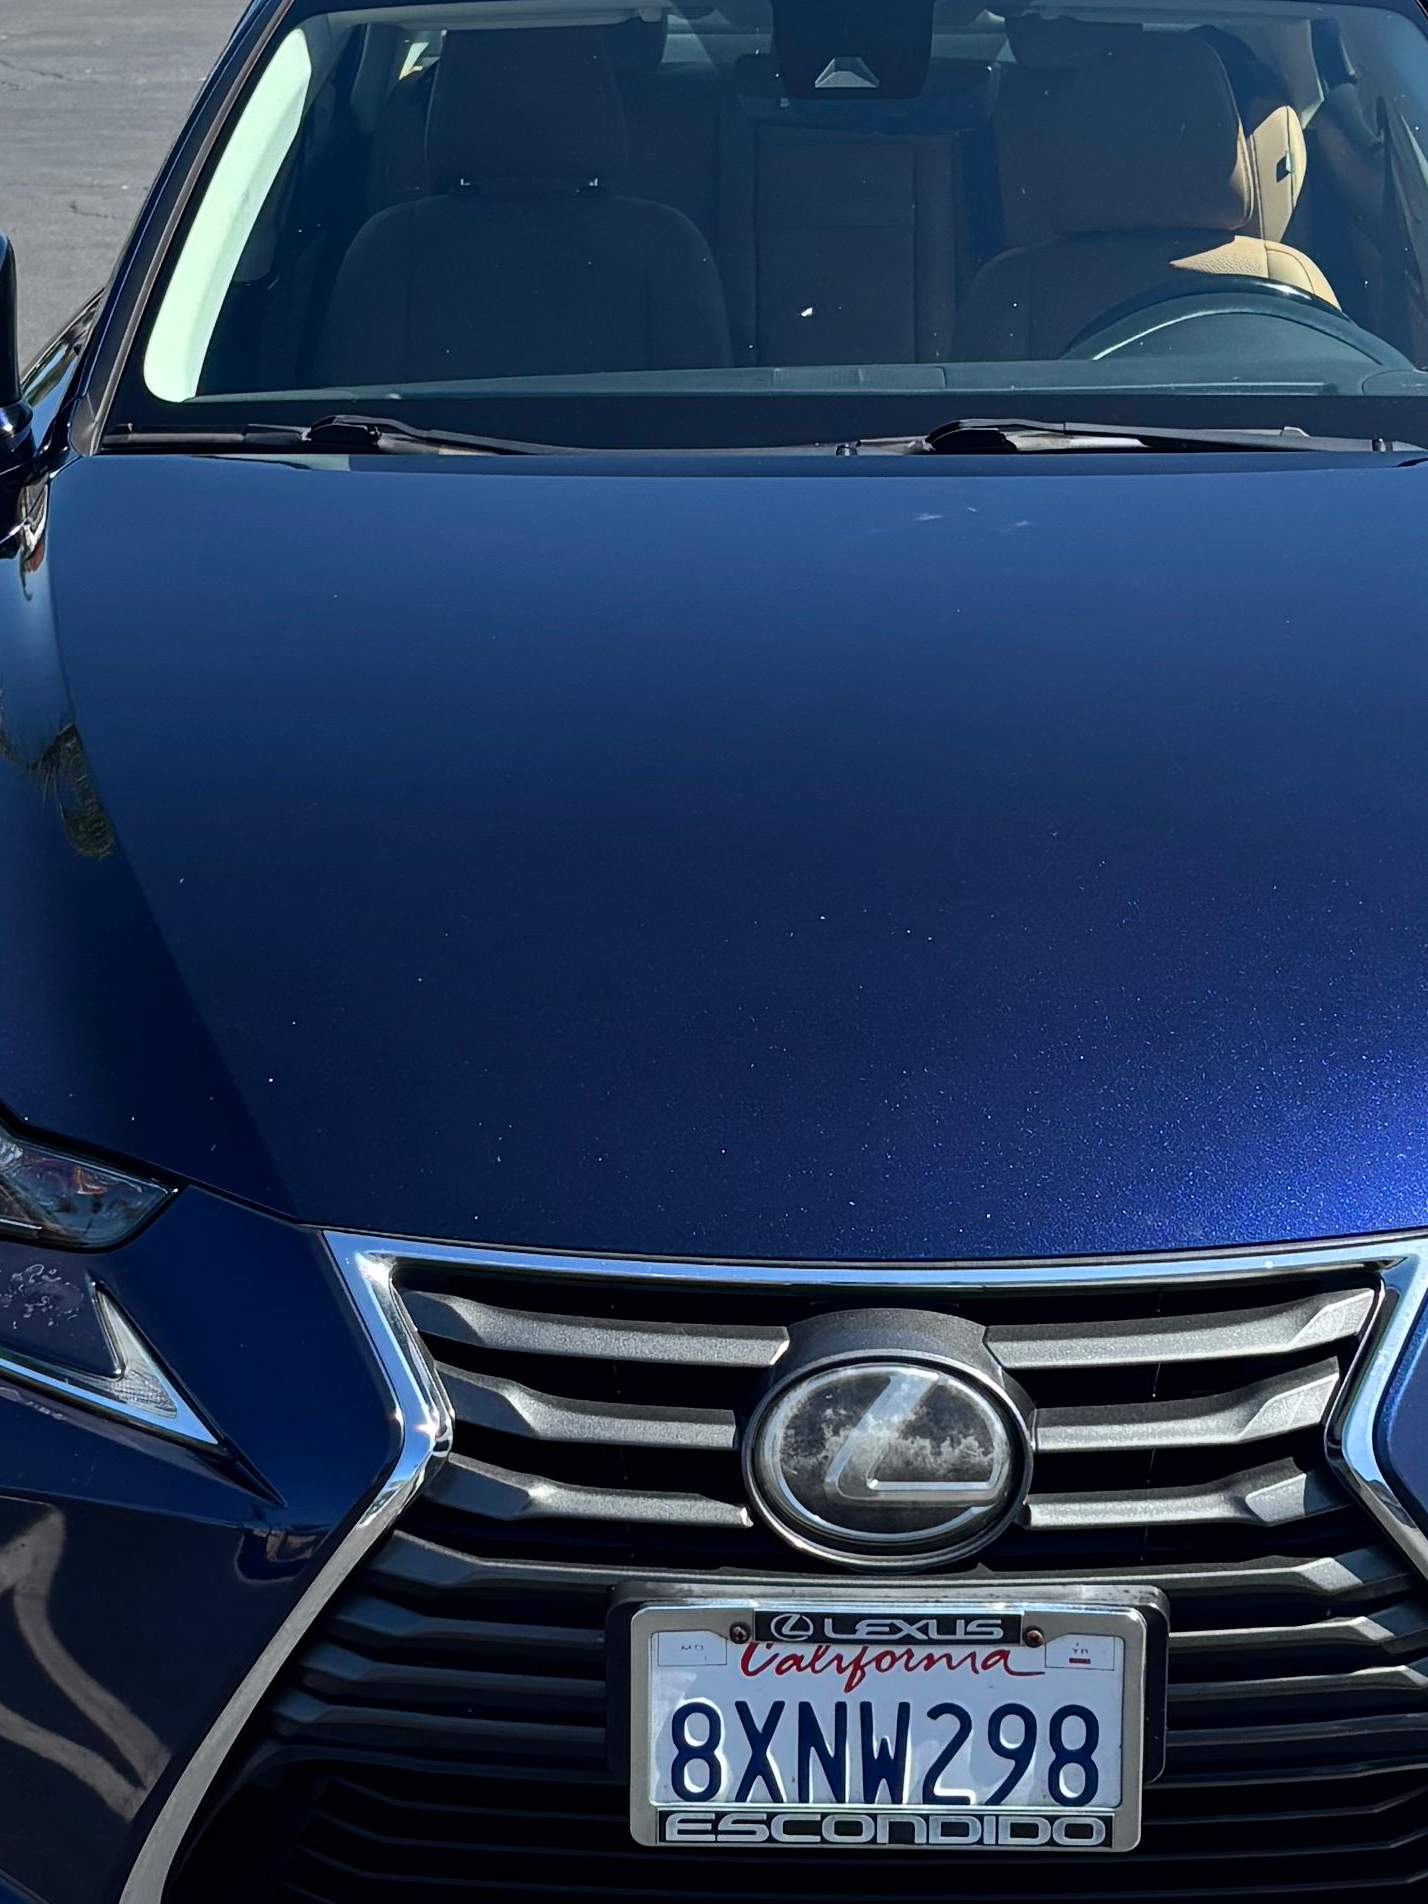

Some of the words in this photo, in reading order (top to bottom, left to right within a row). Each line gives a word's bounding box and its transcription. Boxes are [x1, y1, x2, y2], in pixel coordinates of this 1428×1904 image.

[824, 1617, 1004, 1641] LEXUS
[740, 1641, 1045, 1693] California
[671, 1699, 1100, 1806] 8XNW298
[665, 1812, 1106, 1845] ESCONDIDO
